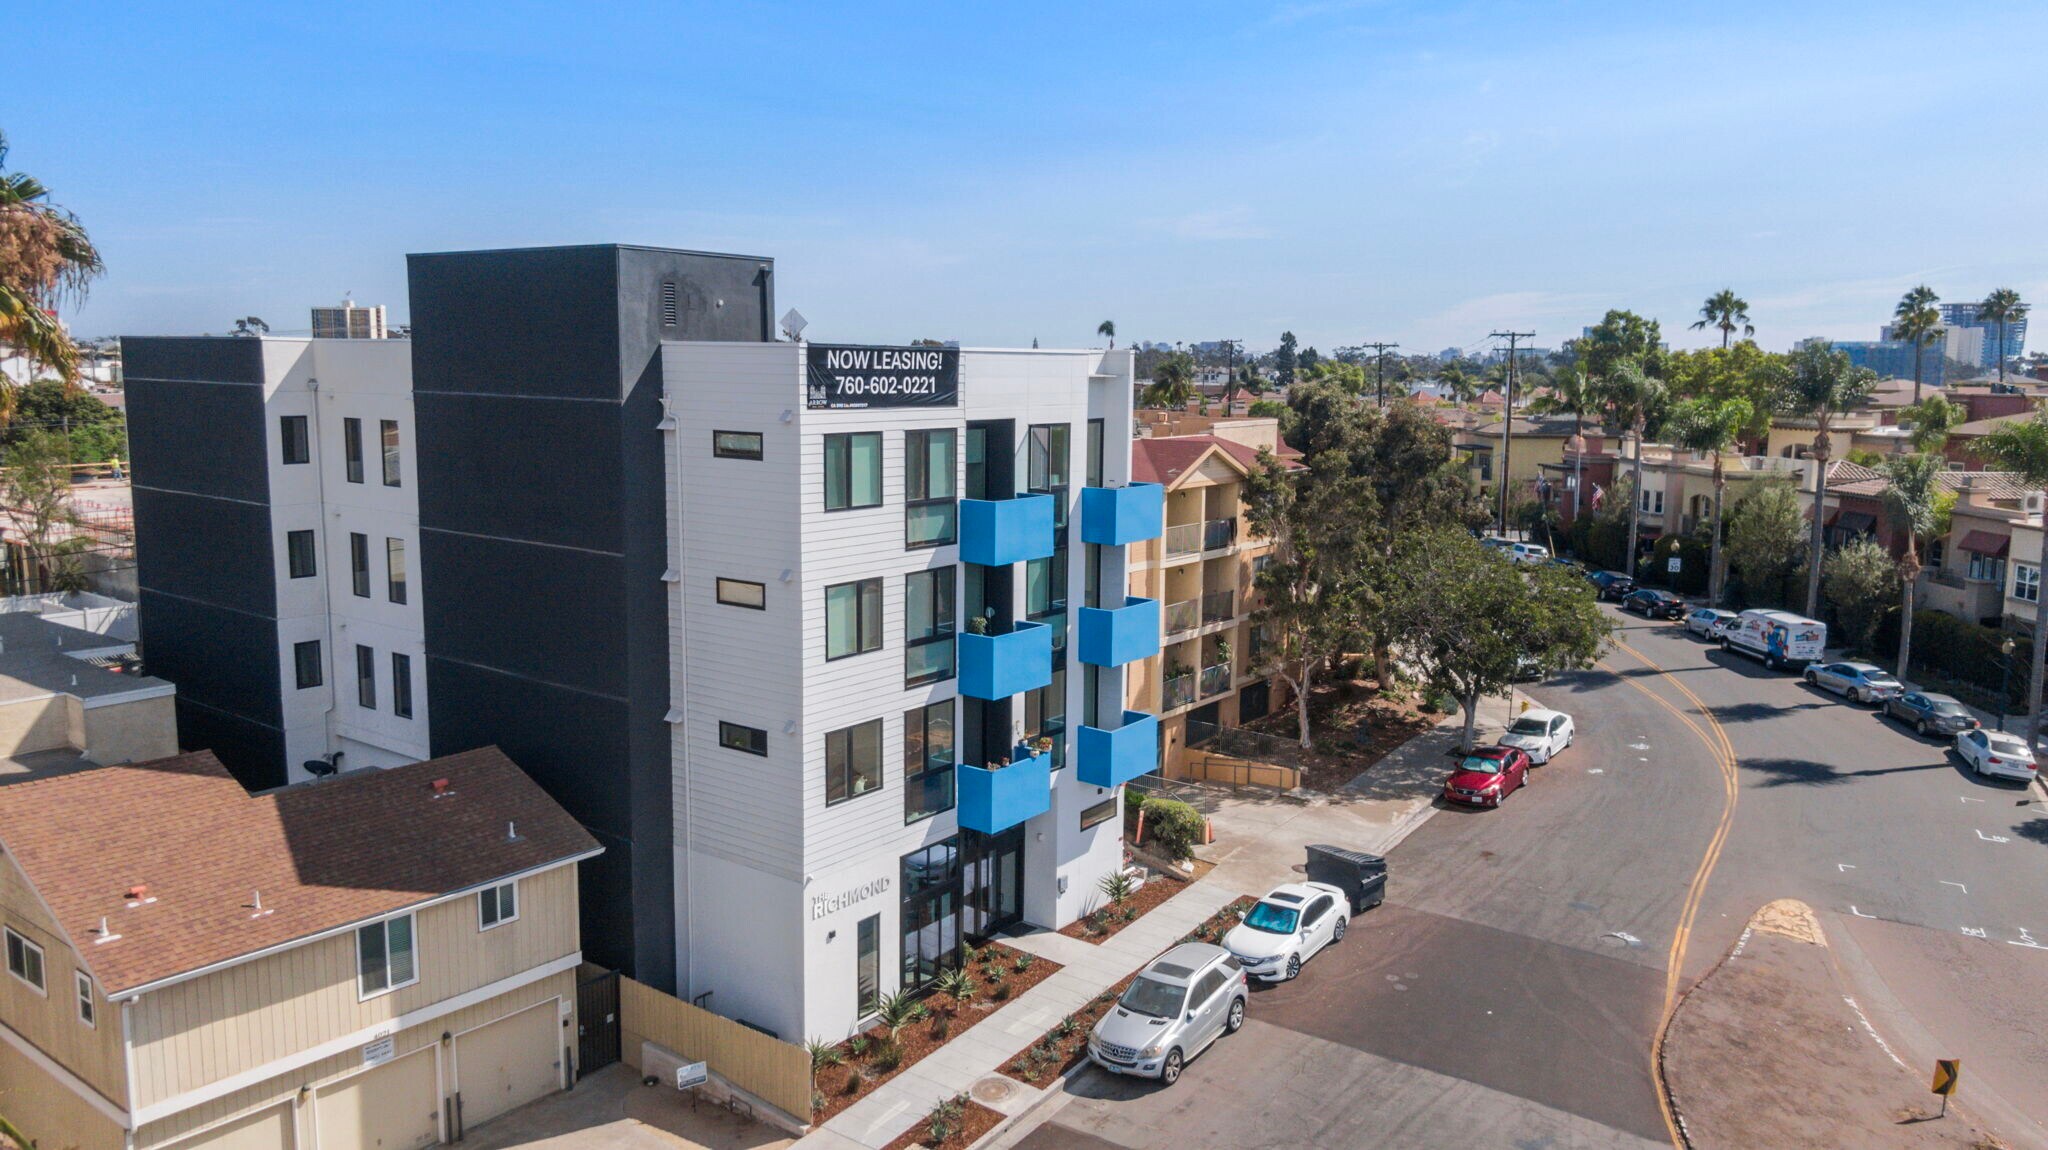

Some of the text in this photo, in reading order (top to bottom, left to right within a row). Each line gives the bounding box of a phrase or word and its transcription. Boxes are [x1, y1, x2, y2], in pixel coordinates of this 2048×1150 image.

[827, 350, 943, 370] NOW LEASING!
[835, 376, 936, 395] 760-602-0221
[812, 876, 890, 921] RICHMOND
